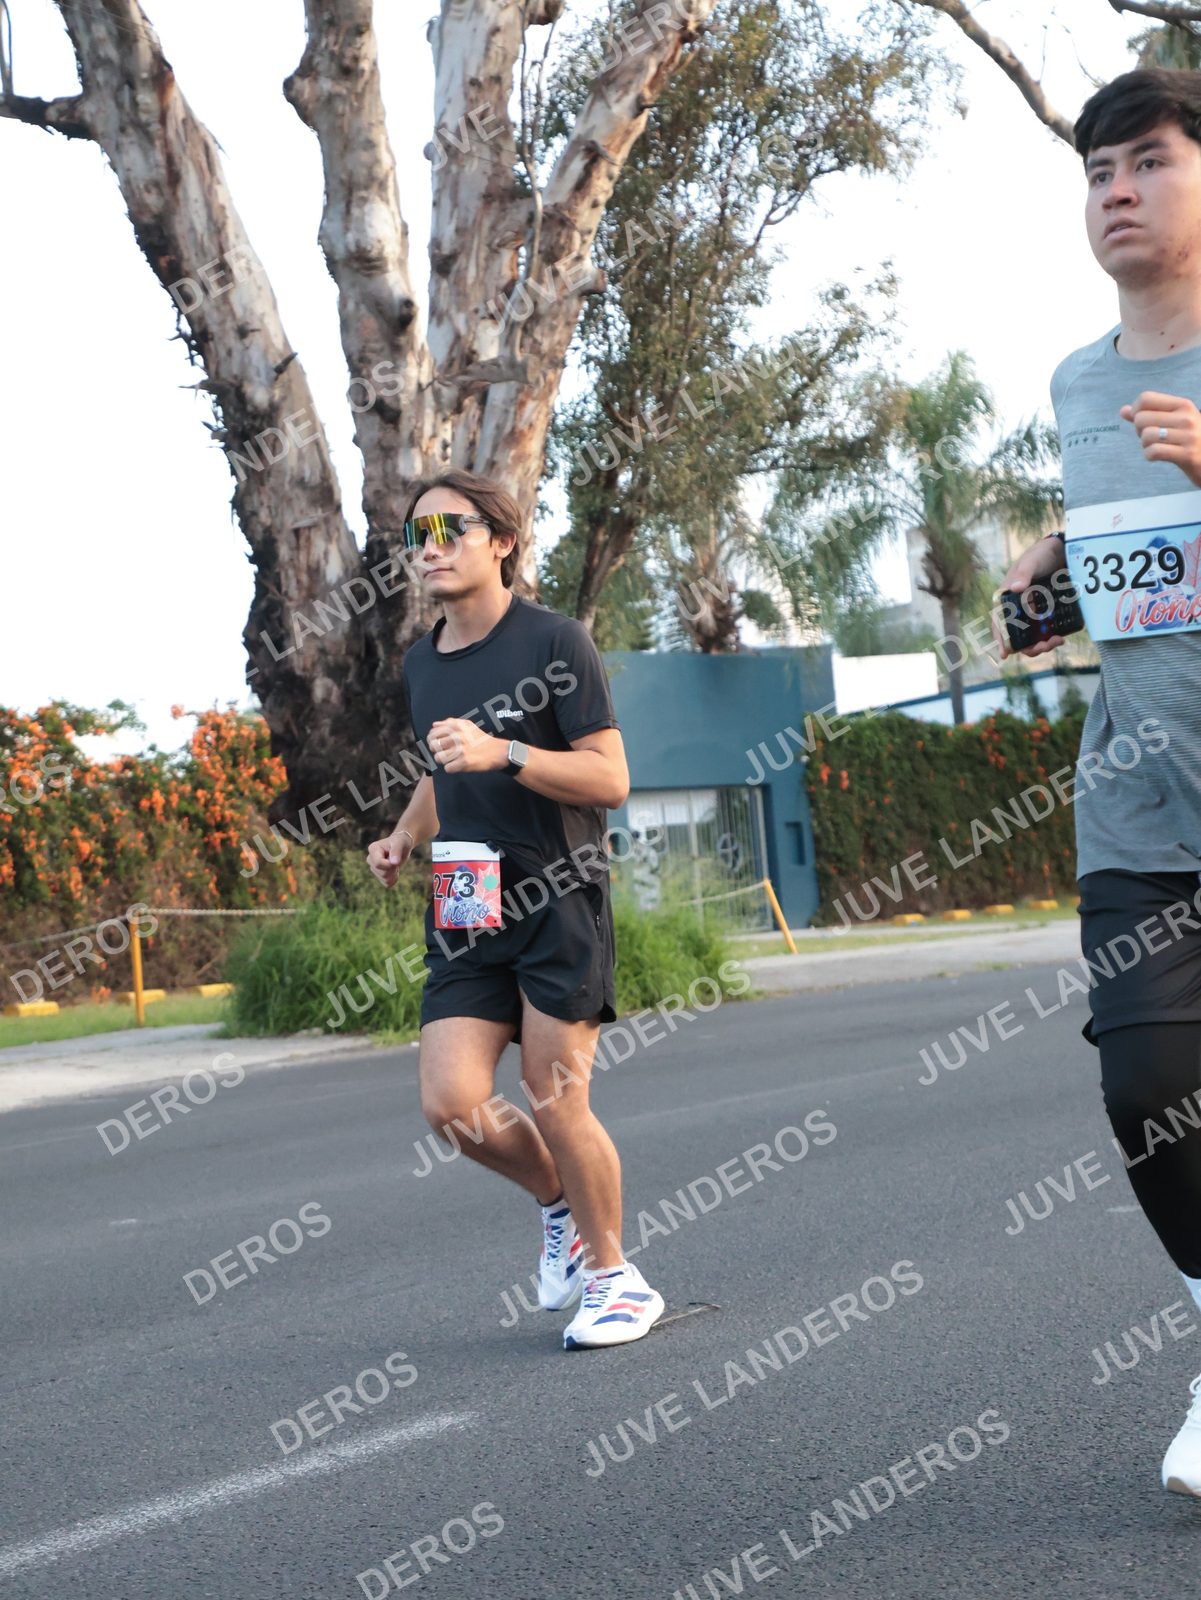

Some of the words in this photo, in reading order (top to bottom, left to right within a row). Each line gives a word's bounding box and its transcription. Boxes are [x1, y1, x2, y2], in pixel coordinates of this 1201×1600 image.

[1084, 546, 1185, 594] 3329
[496, 709, 523, 718] Wilson
[434, 872, 476, 899] 273
